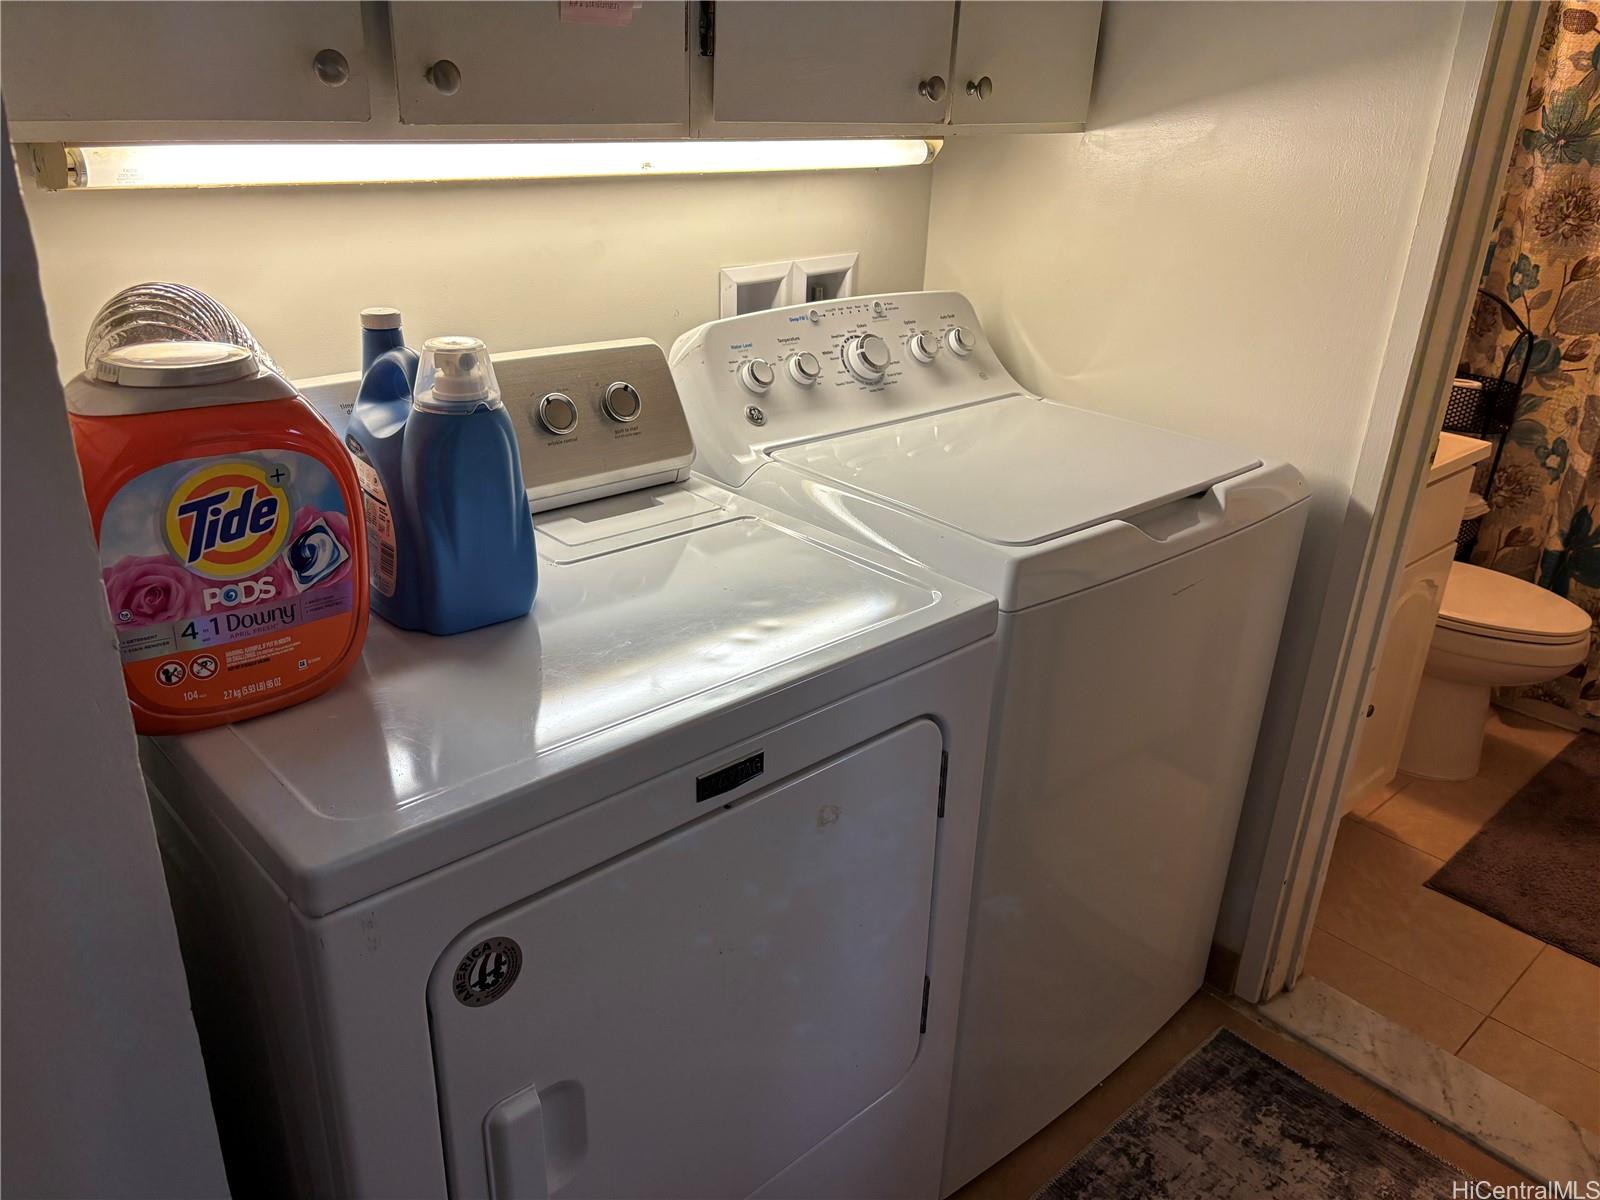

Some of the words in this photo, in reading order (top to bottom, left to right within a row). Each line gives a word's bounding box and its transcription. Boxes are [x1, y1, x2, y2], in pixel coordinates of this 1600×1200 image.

[177, 485, 279, 567] Tide
[203, 576, 277, 611] PODS
[181, 621, 199, 640] 4
[209, 617, 220, 635] 1
[226, 603, 296, 633] Downy
[183, 690, 199, 701] 104
[223, 690, 233, 700] 2.7
[233, 688, 241, 699] kg
[455, 943, 491, 1001] AMERICA
